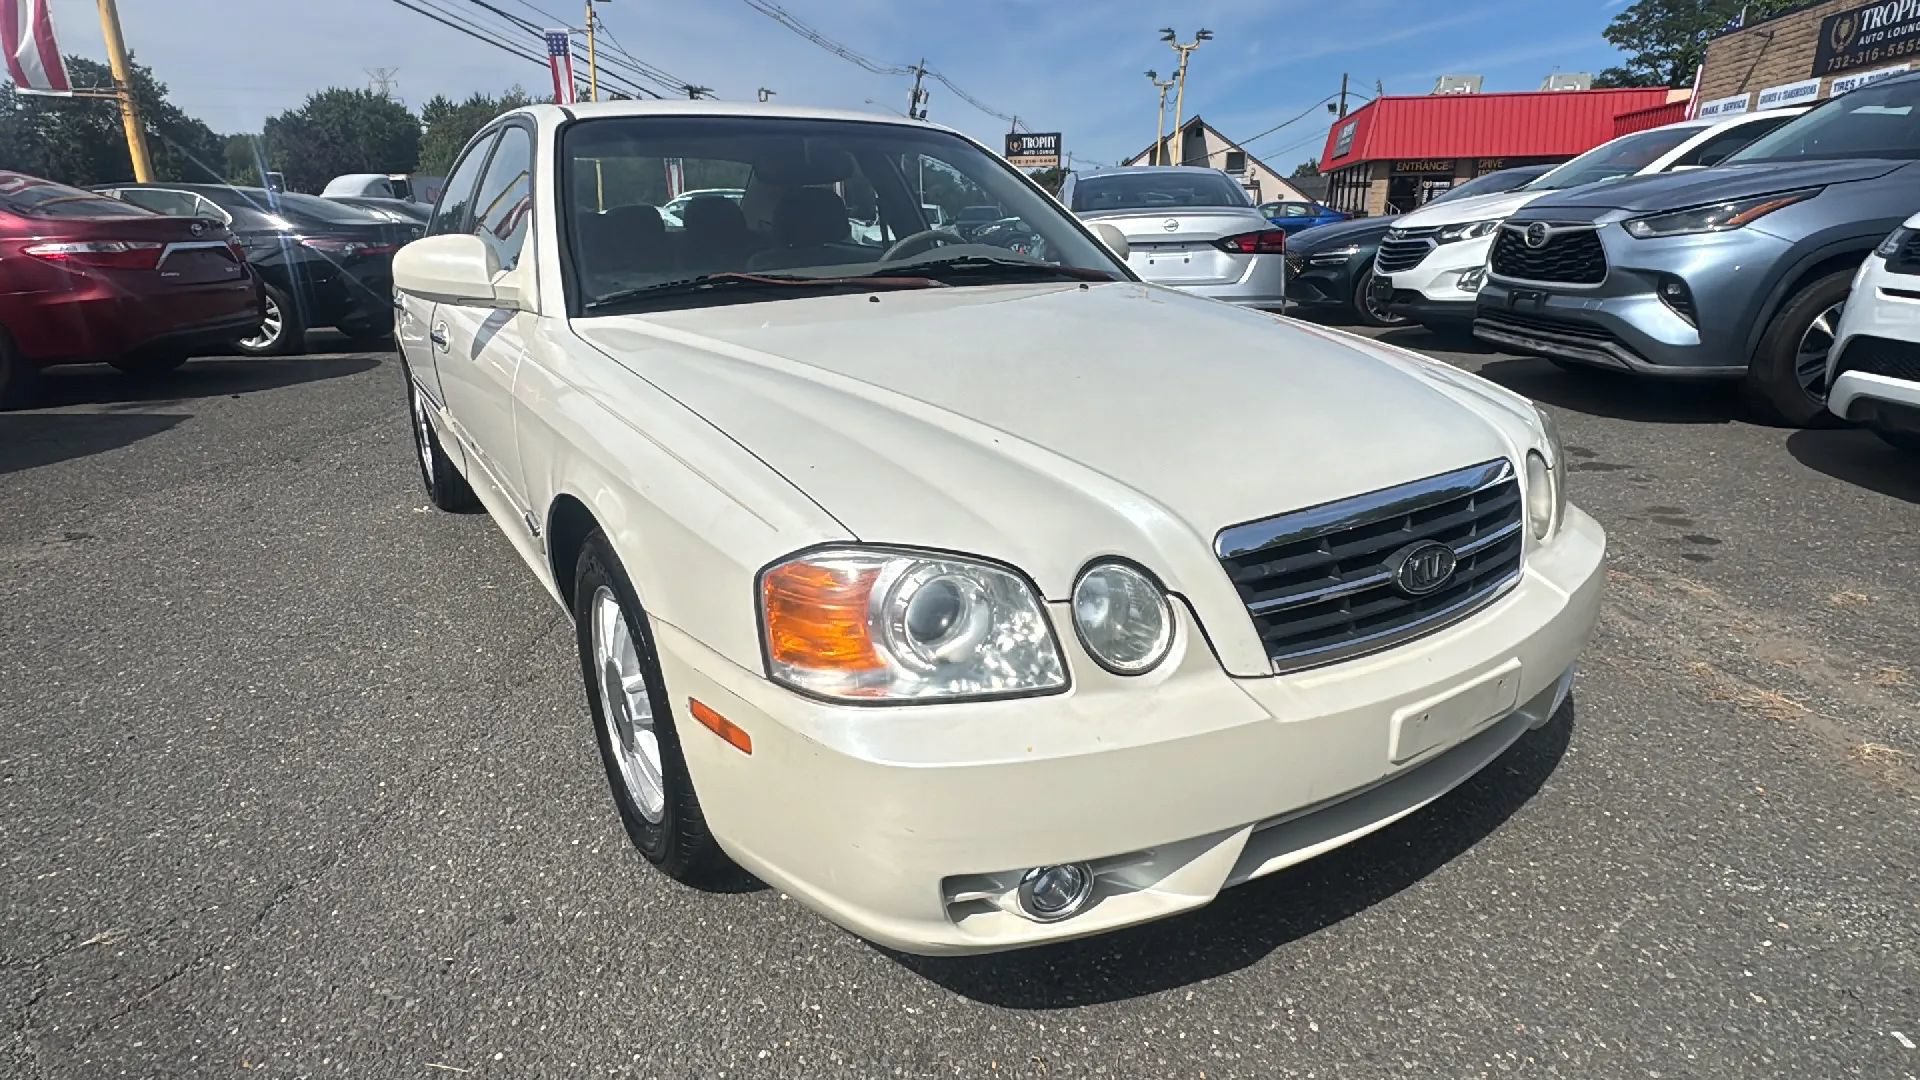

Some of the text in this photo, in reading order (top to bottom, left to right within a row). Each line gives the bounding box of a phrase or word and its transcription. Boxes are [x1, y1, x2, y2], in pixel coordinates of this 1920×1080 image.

[1858, 31, 1884, 46] AUTO
[1834, 79, 1856, 93] TIRES
[1022, 136, 1056, 149] TROPHY
[1396, 161, 1449, 172] ENTRANCE
